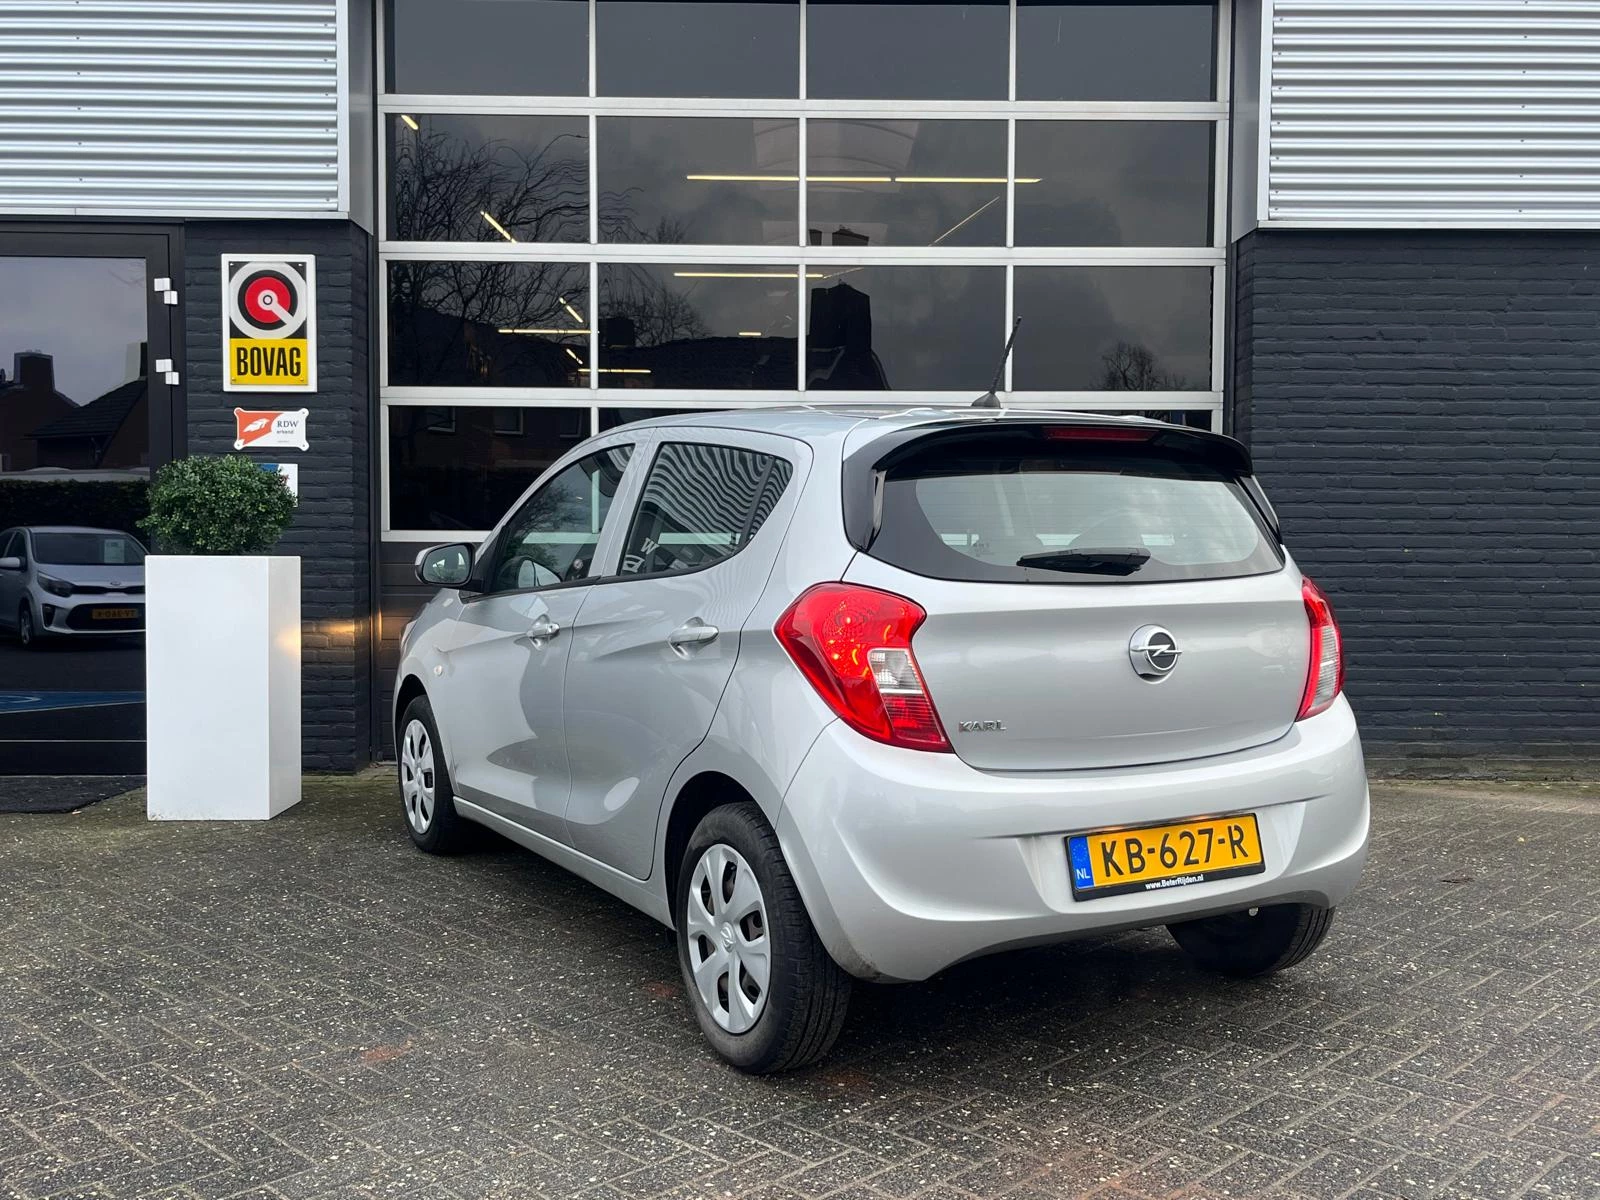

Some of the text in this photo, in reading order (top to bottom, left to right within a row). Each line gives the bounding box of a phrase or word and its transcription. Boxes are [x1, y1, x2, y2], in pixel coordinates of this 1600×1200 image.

[236, 347, 301, 377] BOVAG
[277, 420, 300, 428] RDW
[959, 720, 1007, 732] KARL
[1101, 824, 1249, 878] KB-627-R
[1076, 869, 1091, 880] NL
[1145, 873, 1204, 890] www.BeterRijden.nl
